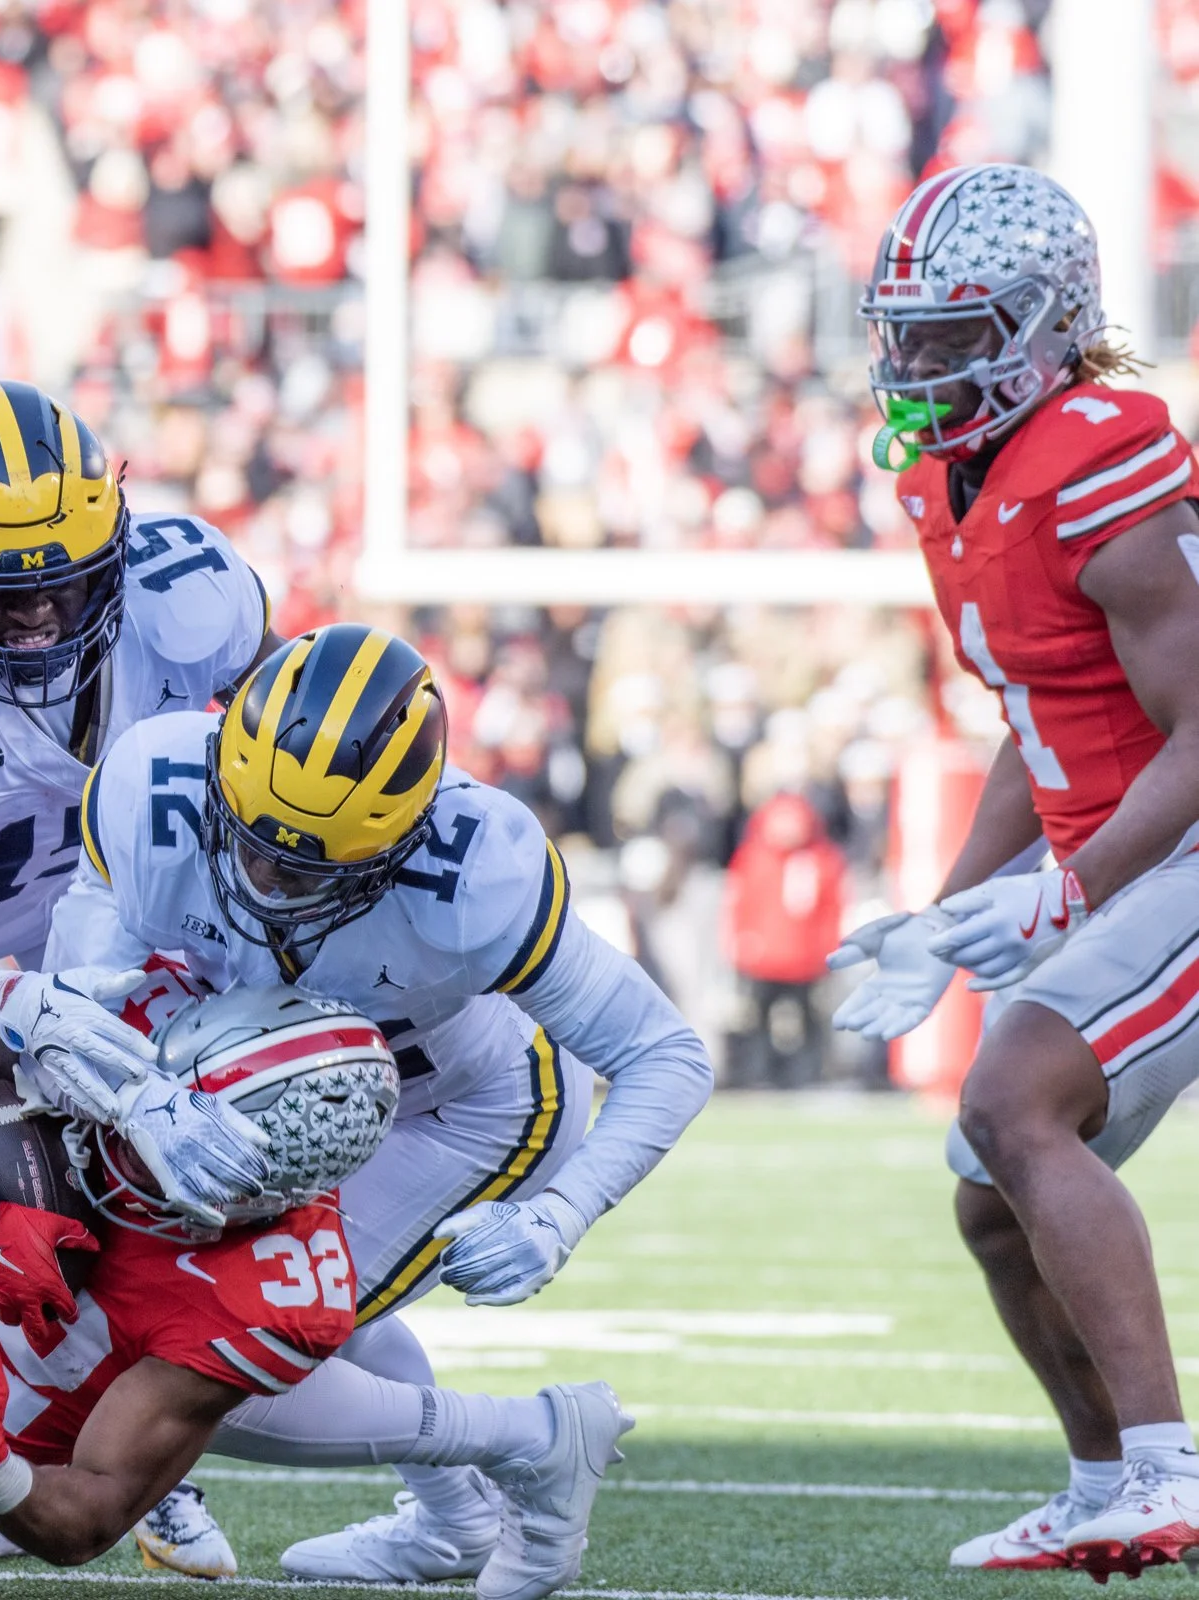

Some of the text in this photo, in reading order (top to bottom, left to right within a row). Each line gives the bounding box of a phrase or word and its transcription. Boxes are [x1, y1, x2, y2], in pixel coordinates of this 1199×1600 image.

[1062, 395, 1121, 424] 1
[21, 551, 45, 570] M
[125, 517, 229, 594] 15
[960, 603, 1069, 790] 1
[276, 826, 300, 848] M
[392, 813, 480, 904] 12
[22, 1140, 40, 1178] ELITE
[252, 1229, 351, 1311] 32
